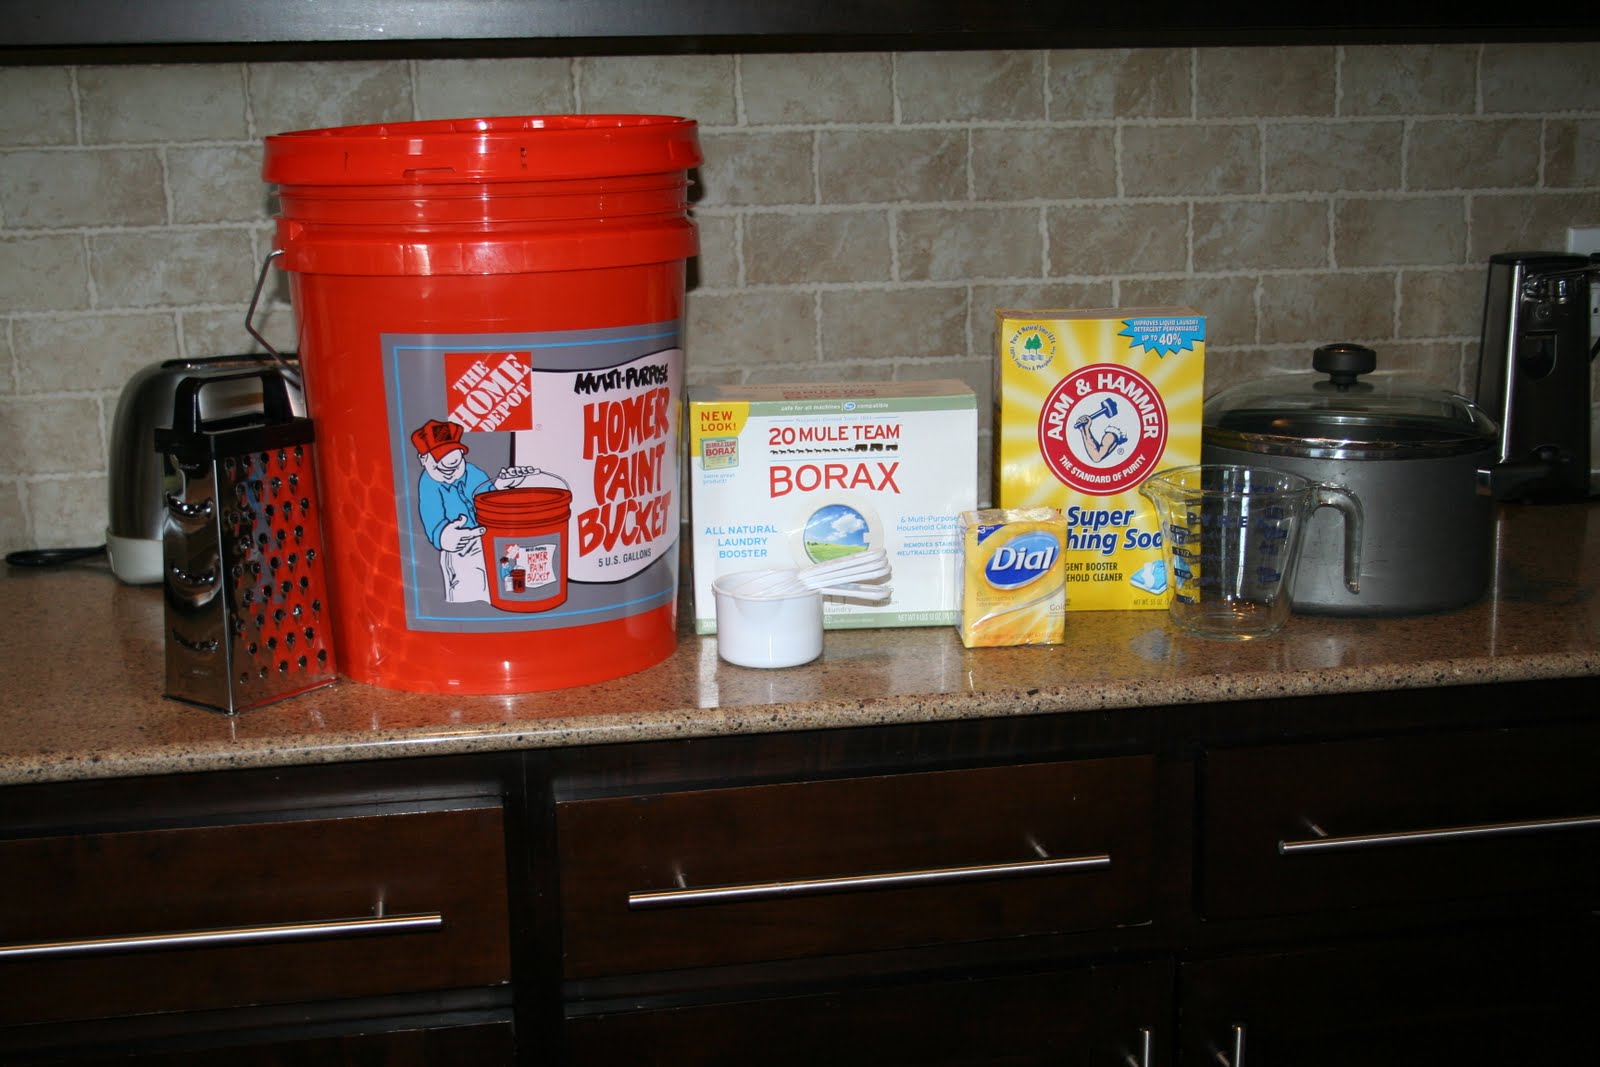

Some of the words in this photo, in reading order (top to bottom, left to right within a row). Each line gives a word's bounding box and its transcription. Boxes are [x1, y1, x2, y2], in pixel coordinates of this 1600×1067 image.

[1159, 333, 1182, 345] 40%
[452, 360, 490, 395] THE
[574, 363, 668, 395] MULTI-PURPOSE
[448, 353, 531, 433] HOME
[478, 382, 532, 432] DEPOT
[701, 411, 733, 421] NEW
[857, 403, 889, 411] compatible
[1047, 393, 1074, 441] ARM
[1075, 378, 1092, 396] &
[1097, 373, 1159, 439] HAMMER
[583, 387, 670, 460] HOMER
[701, 423, 737, 432] LOOK!
[769, 427, 796, 446] 20
[799, 426, 849, 442] MULE
[852, 424, 900, 440] TEAM
[705, 447, 736, 457] BORAX
[593, 440, 666, 507] PAINT
[769, 462, 902, 499] BORAX
[1059, 455, 1073, 471] THE
[1070, 466, 1112, 484] STANDARD
[1112, 472, 1123, 482] OF
[1123, 454, 1147, 478] PURITY
[577, 490, 672, 557] BUCKET
[705, 527, 725, 535] ALL
[728, 525, 778, 535] NATURAL
[1067, 506, 1135, 531] Super
[718, 537, 768, 546] LAUNDRY
[719, 549, 768, 558] BOOSTER
[1067, 528, 1118, 555] hing
[598, 559, 604, 568] 5
[605, 556, 621, 567] U.S.
[623, 547, 652, 563] GALLONS
[991, 546, 1055, 571] Dial
[1086, 562, 1118, 571] BOOSTER
[1067, 573, 1090, 582] EHOLD
[1092, 573, 1123, 582] CLEANER
